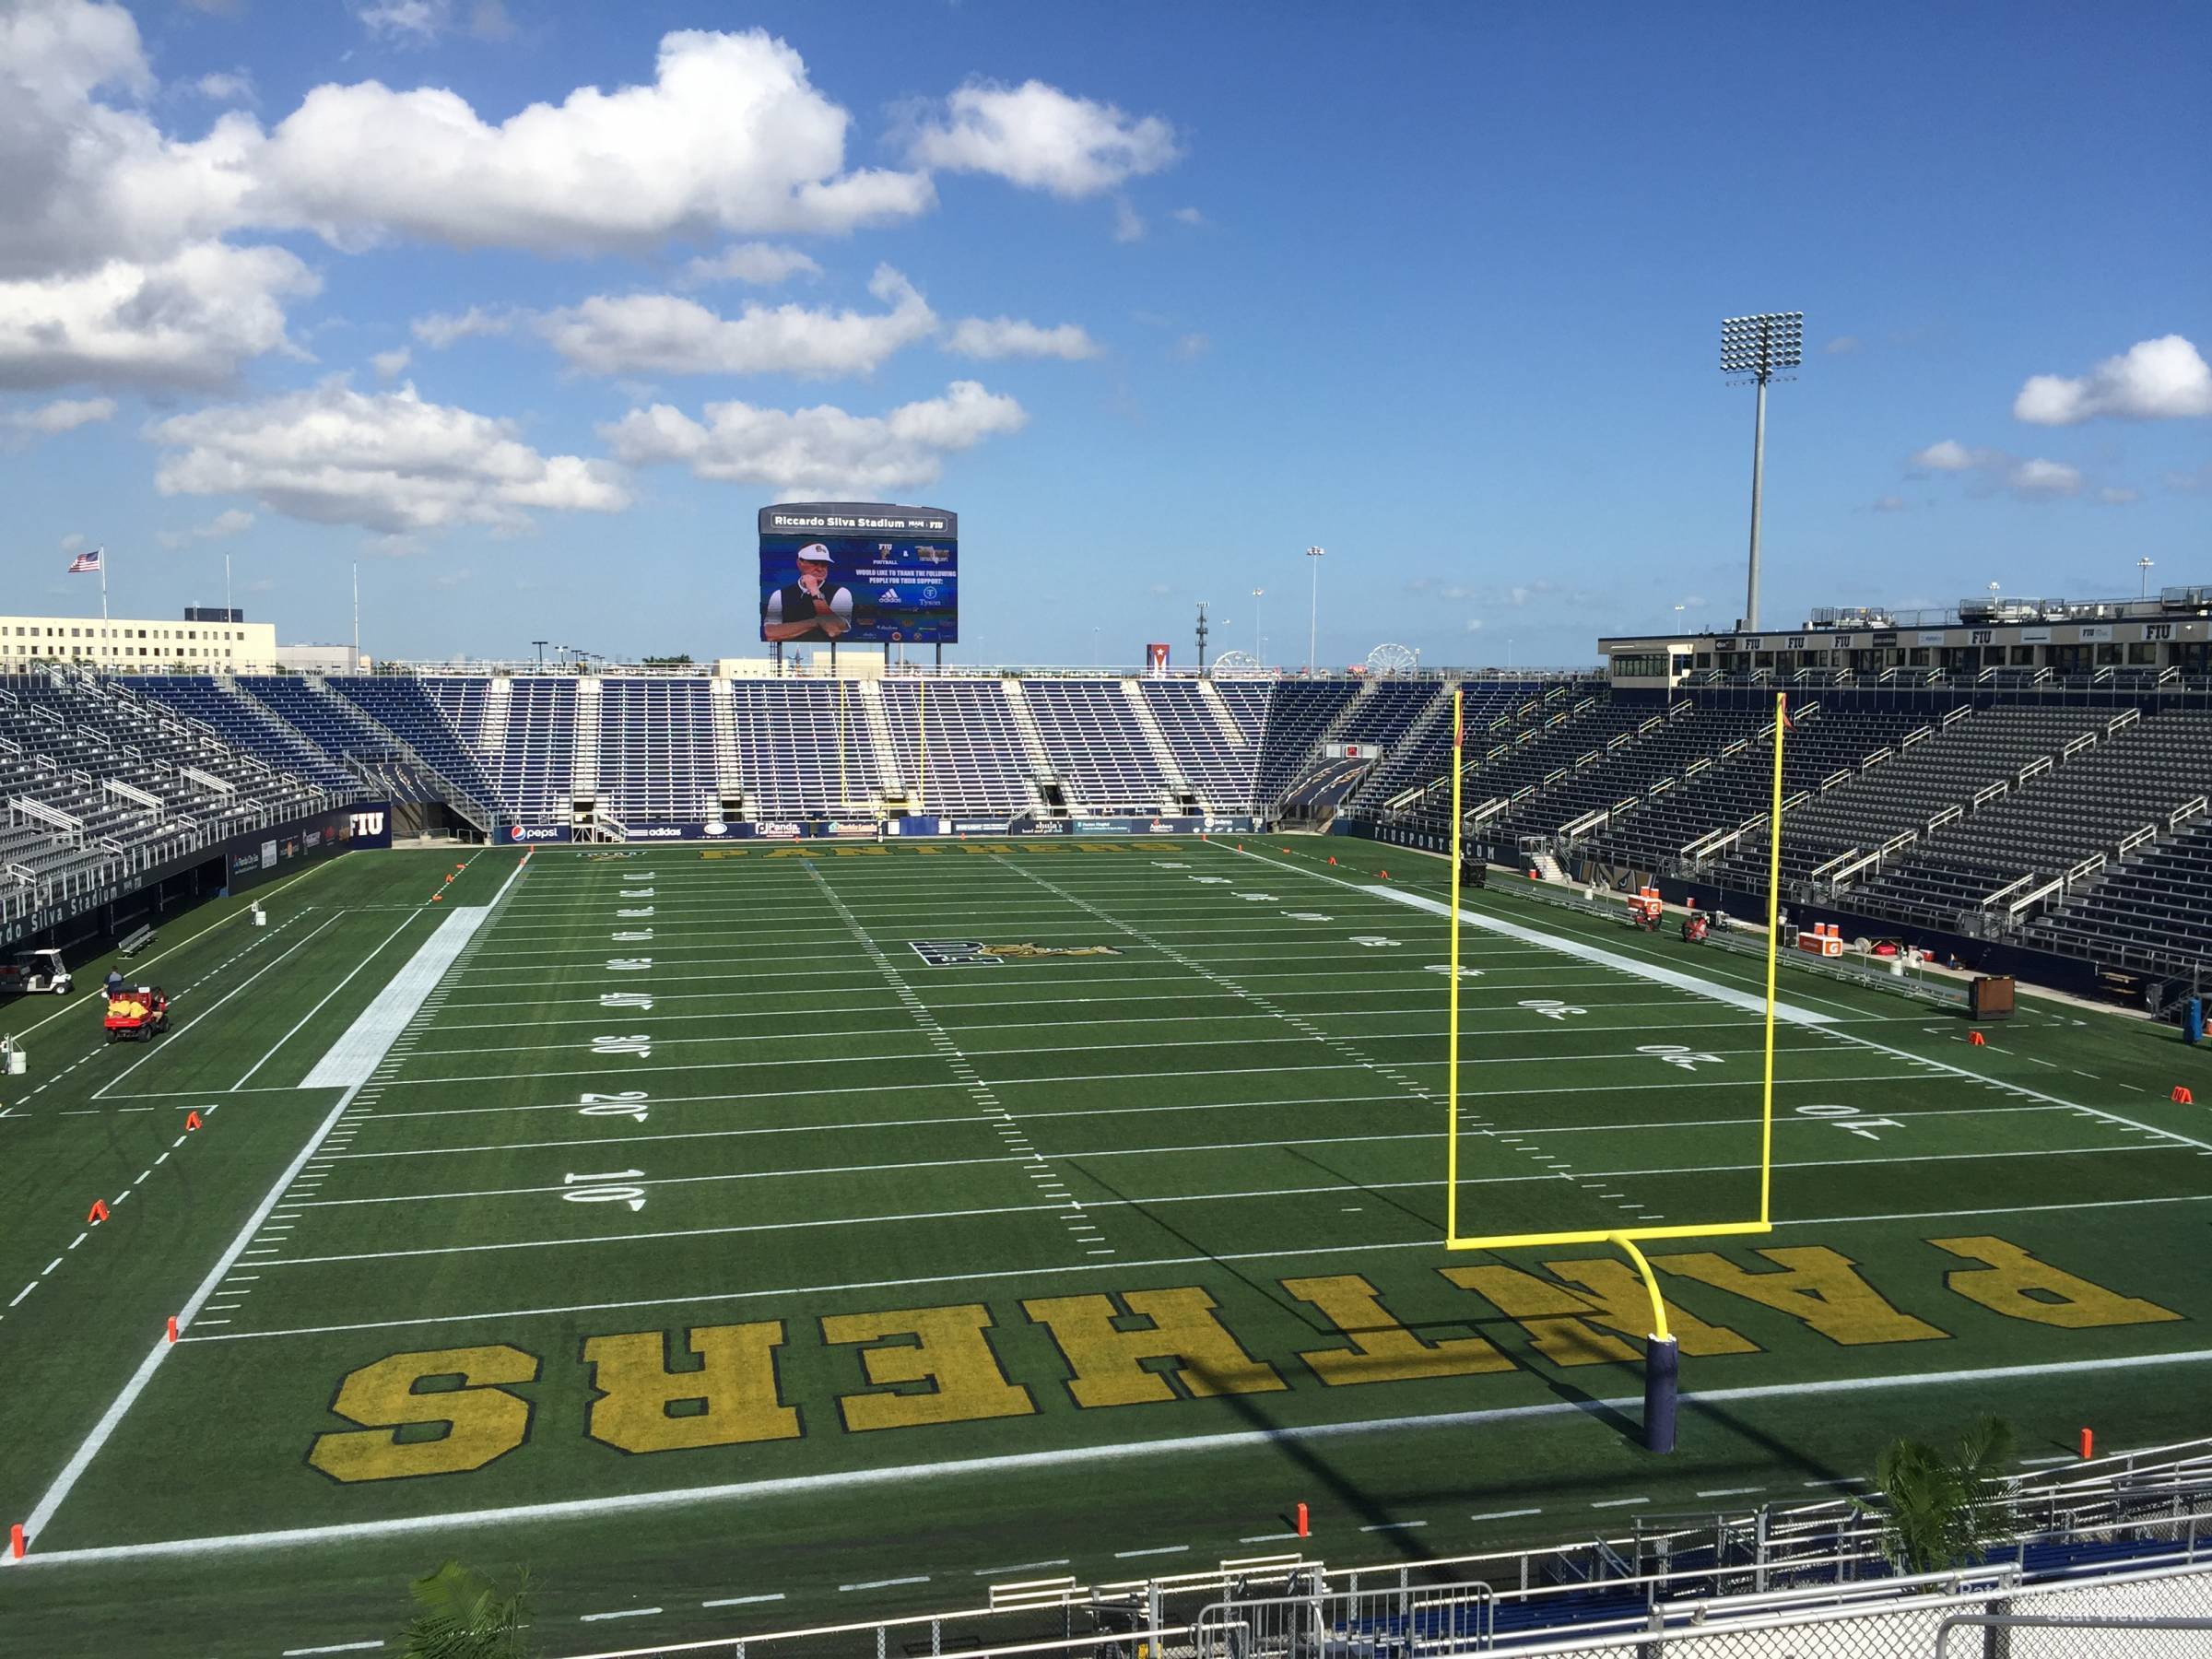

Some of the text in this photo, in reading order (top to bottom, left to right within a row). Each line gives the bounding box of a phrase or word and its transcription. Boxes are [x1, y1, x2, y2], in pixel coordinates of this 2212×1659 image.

[774, 516, 825, 526] Riccardo
[827, 516, 856, 527] Silva
[858, 518, 905, 528] Stadium
[929, 521, 944, 529] FIU
[1972, 630, 1992, 644] FIU
[2082, 629, 2095, 637] FIU
[2147, 624, 2171, 640] FIU
[1746, 639, 1760, 649] FIU
[1788, 637, 1805, 648] FIU
[1835, 636, 1851, 647] FIU
[349, 812, 384, 837] FIU
[648, 827, 682, 837] adidas
[1035, 821, 1063, 830] shula's
[526, 828, 559, 839] pepsi
[699, 843, 1183, 859] PANTHERS
[1374, 827, 1495, 860] FIUSPORTSCOM
[31, 907, 63, 932] Silva
[71, 886, 117, 915] Stadium
[1829, 943, 1839, 954] G
[599, 993, 653, 1006] 40
[1517, 999, 1587, 1016] 30
[591, 1034, 651, 1053] 30
[1635, 1044, 1725, 1064] 20
[2173, 1088, 2183, 1100] 10
[578, 1091, 649, 1115] 20
[1794, 1104, 1907, 1130] 10
[562, 1169, 646, 1203] 10
[305, 1235, 2189, 1484] PANTHERS
